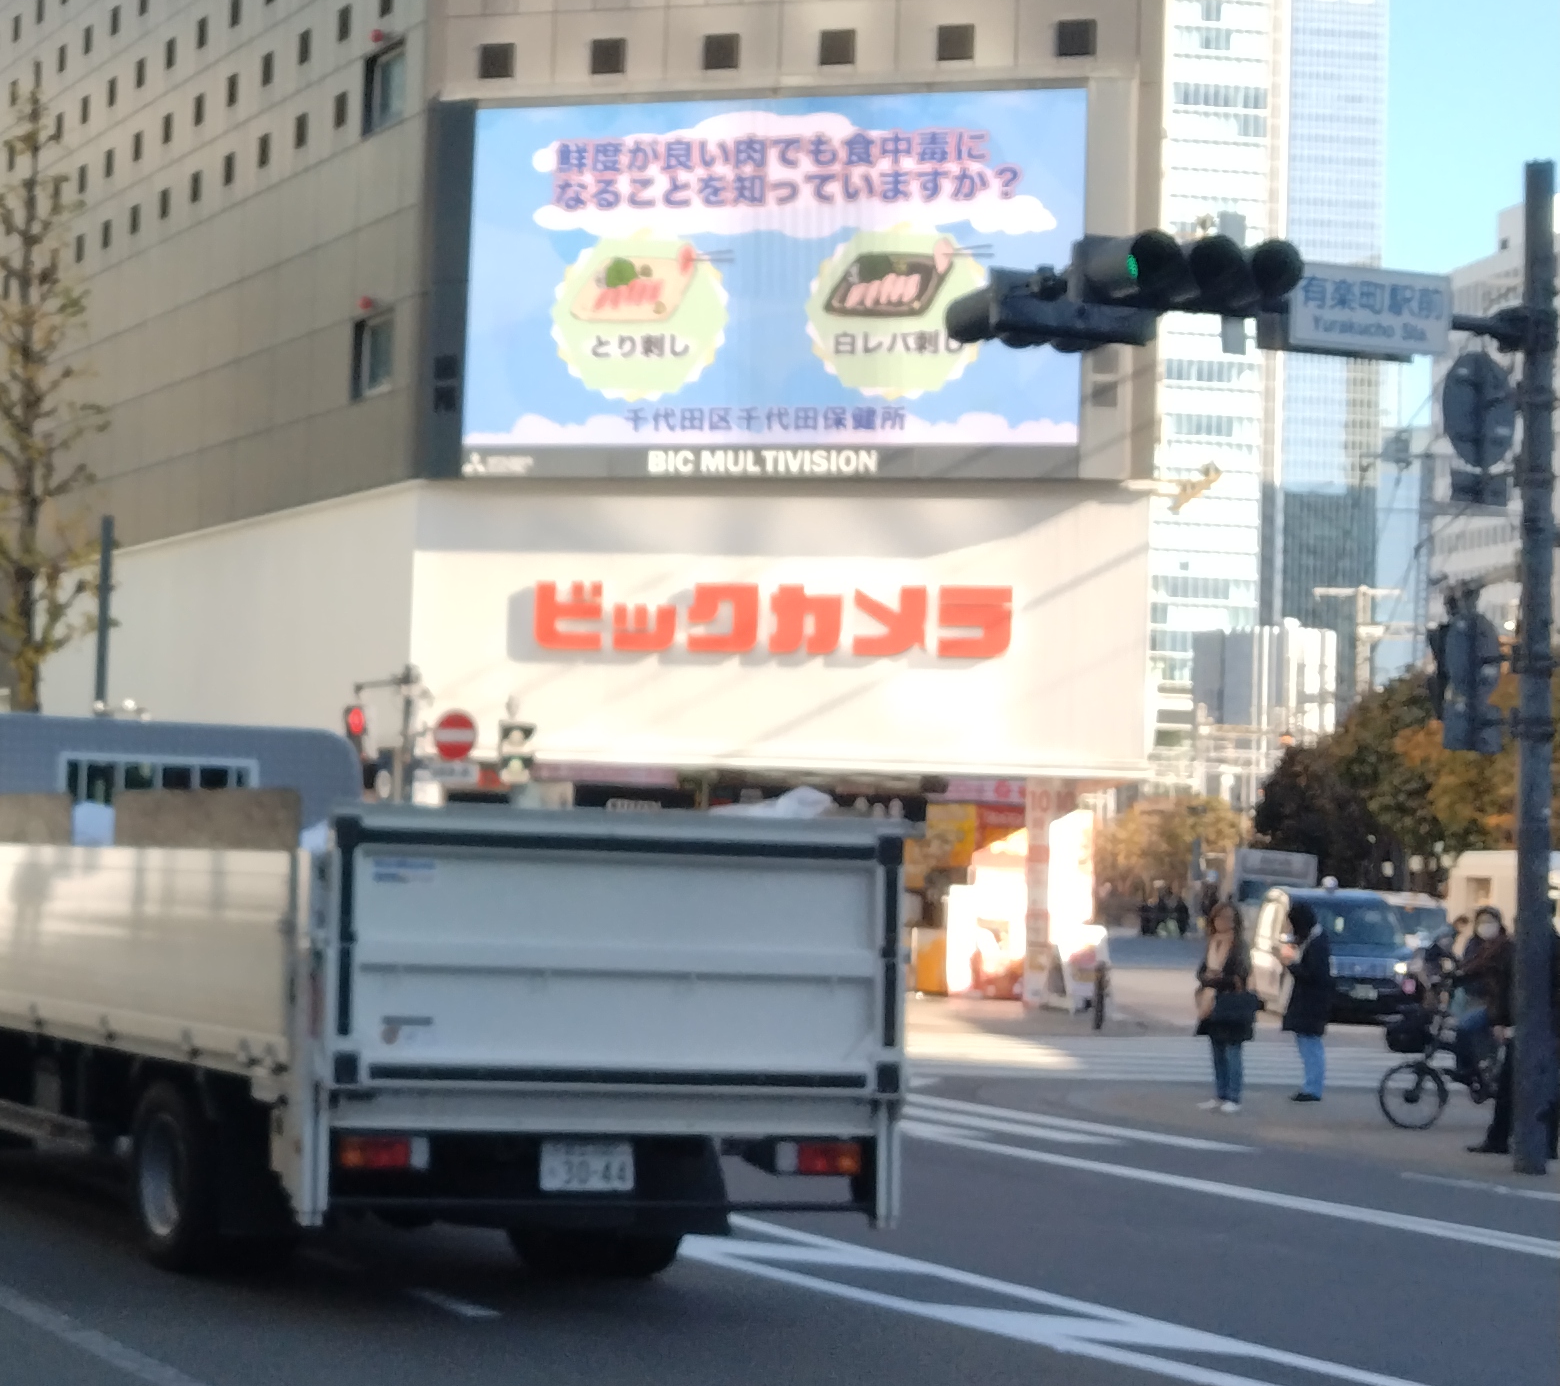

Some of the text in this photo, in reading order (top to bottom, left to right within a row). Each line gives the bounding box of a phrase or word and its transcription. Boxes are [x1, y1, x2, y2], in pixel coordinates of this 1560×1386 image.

[555, 130, 990, 175] 鮮度が良い肉でも食中毒に
[1301, 275, 1443, 321] 有楽町駅前
[590, 333, 691, 359] とり刺し
[833, 330, 965, 356] 白レバ刺し
[624, 405, 907, 433] 千代田区千代田保健所
[646, 448, 880, 476] BIC MULTIVISION
[533, 580, 1013, 658] ビックカメラ
